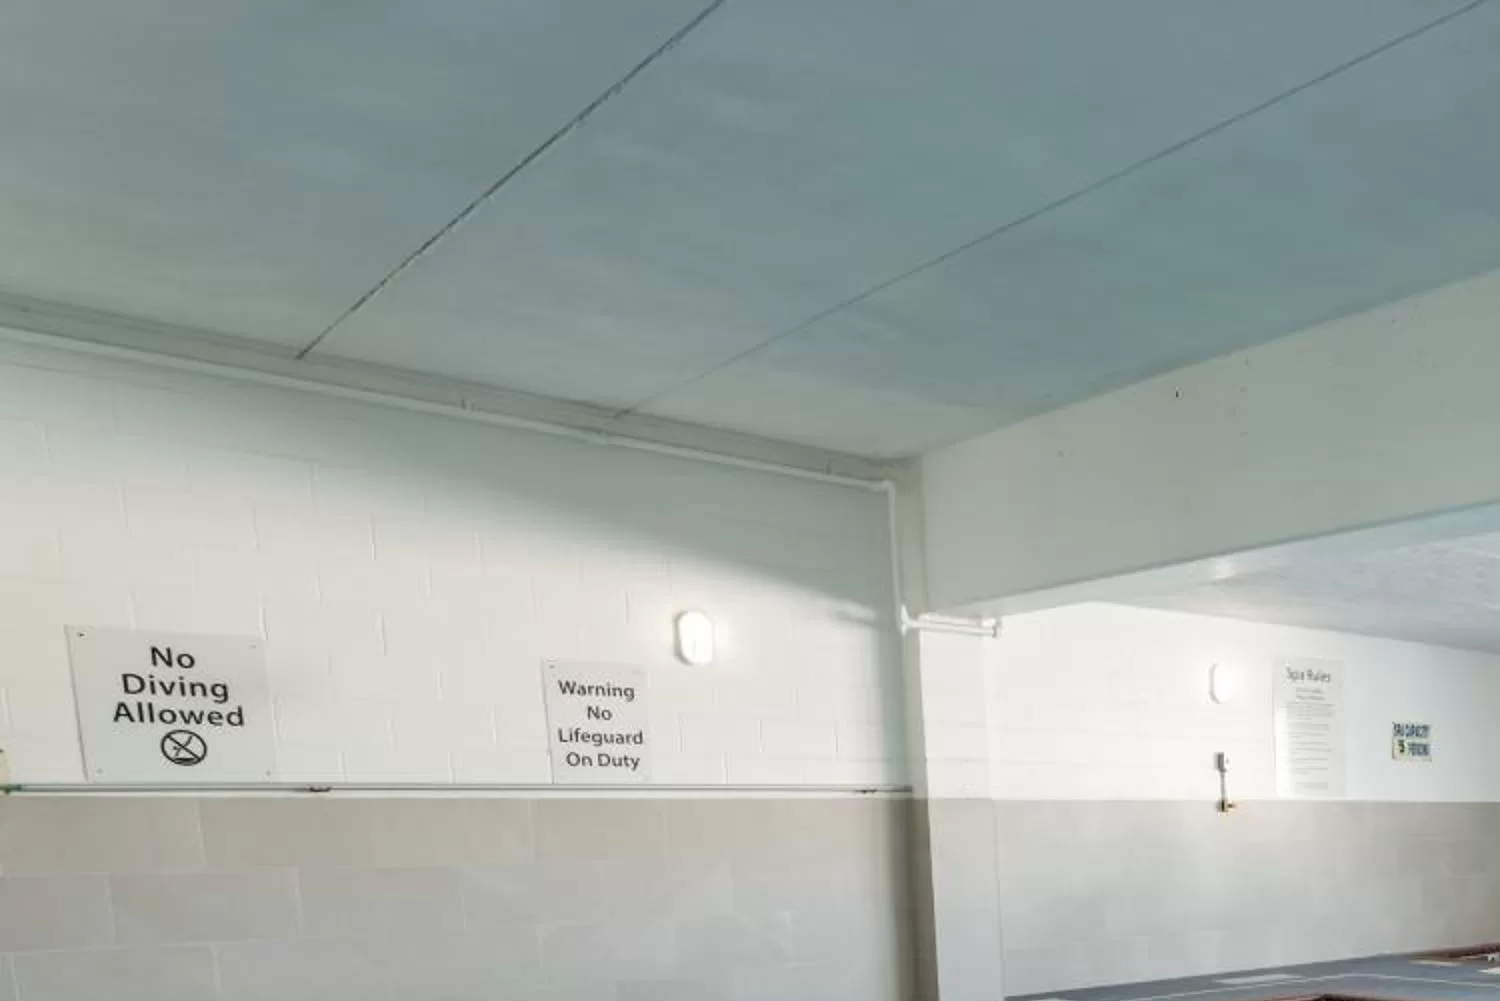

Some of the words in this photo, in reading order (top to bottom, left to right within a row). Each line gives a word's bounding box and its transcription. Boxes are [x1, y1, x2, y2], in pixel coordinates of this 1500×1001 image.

[150, 646, 195, 668] No
[121, 673, 229, 704] Diving
[557, 679, 635, 702] Warning
[112, 701, 244, 726] Allowed
[587, 705, 613, 720] No
[557, 727, 643, 747] Lifeguard
[566, 751, 593, 767] On
[597, 752, 640, 771] Duty
